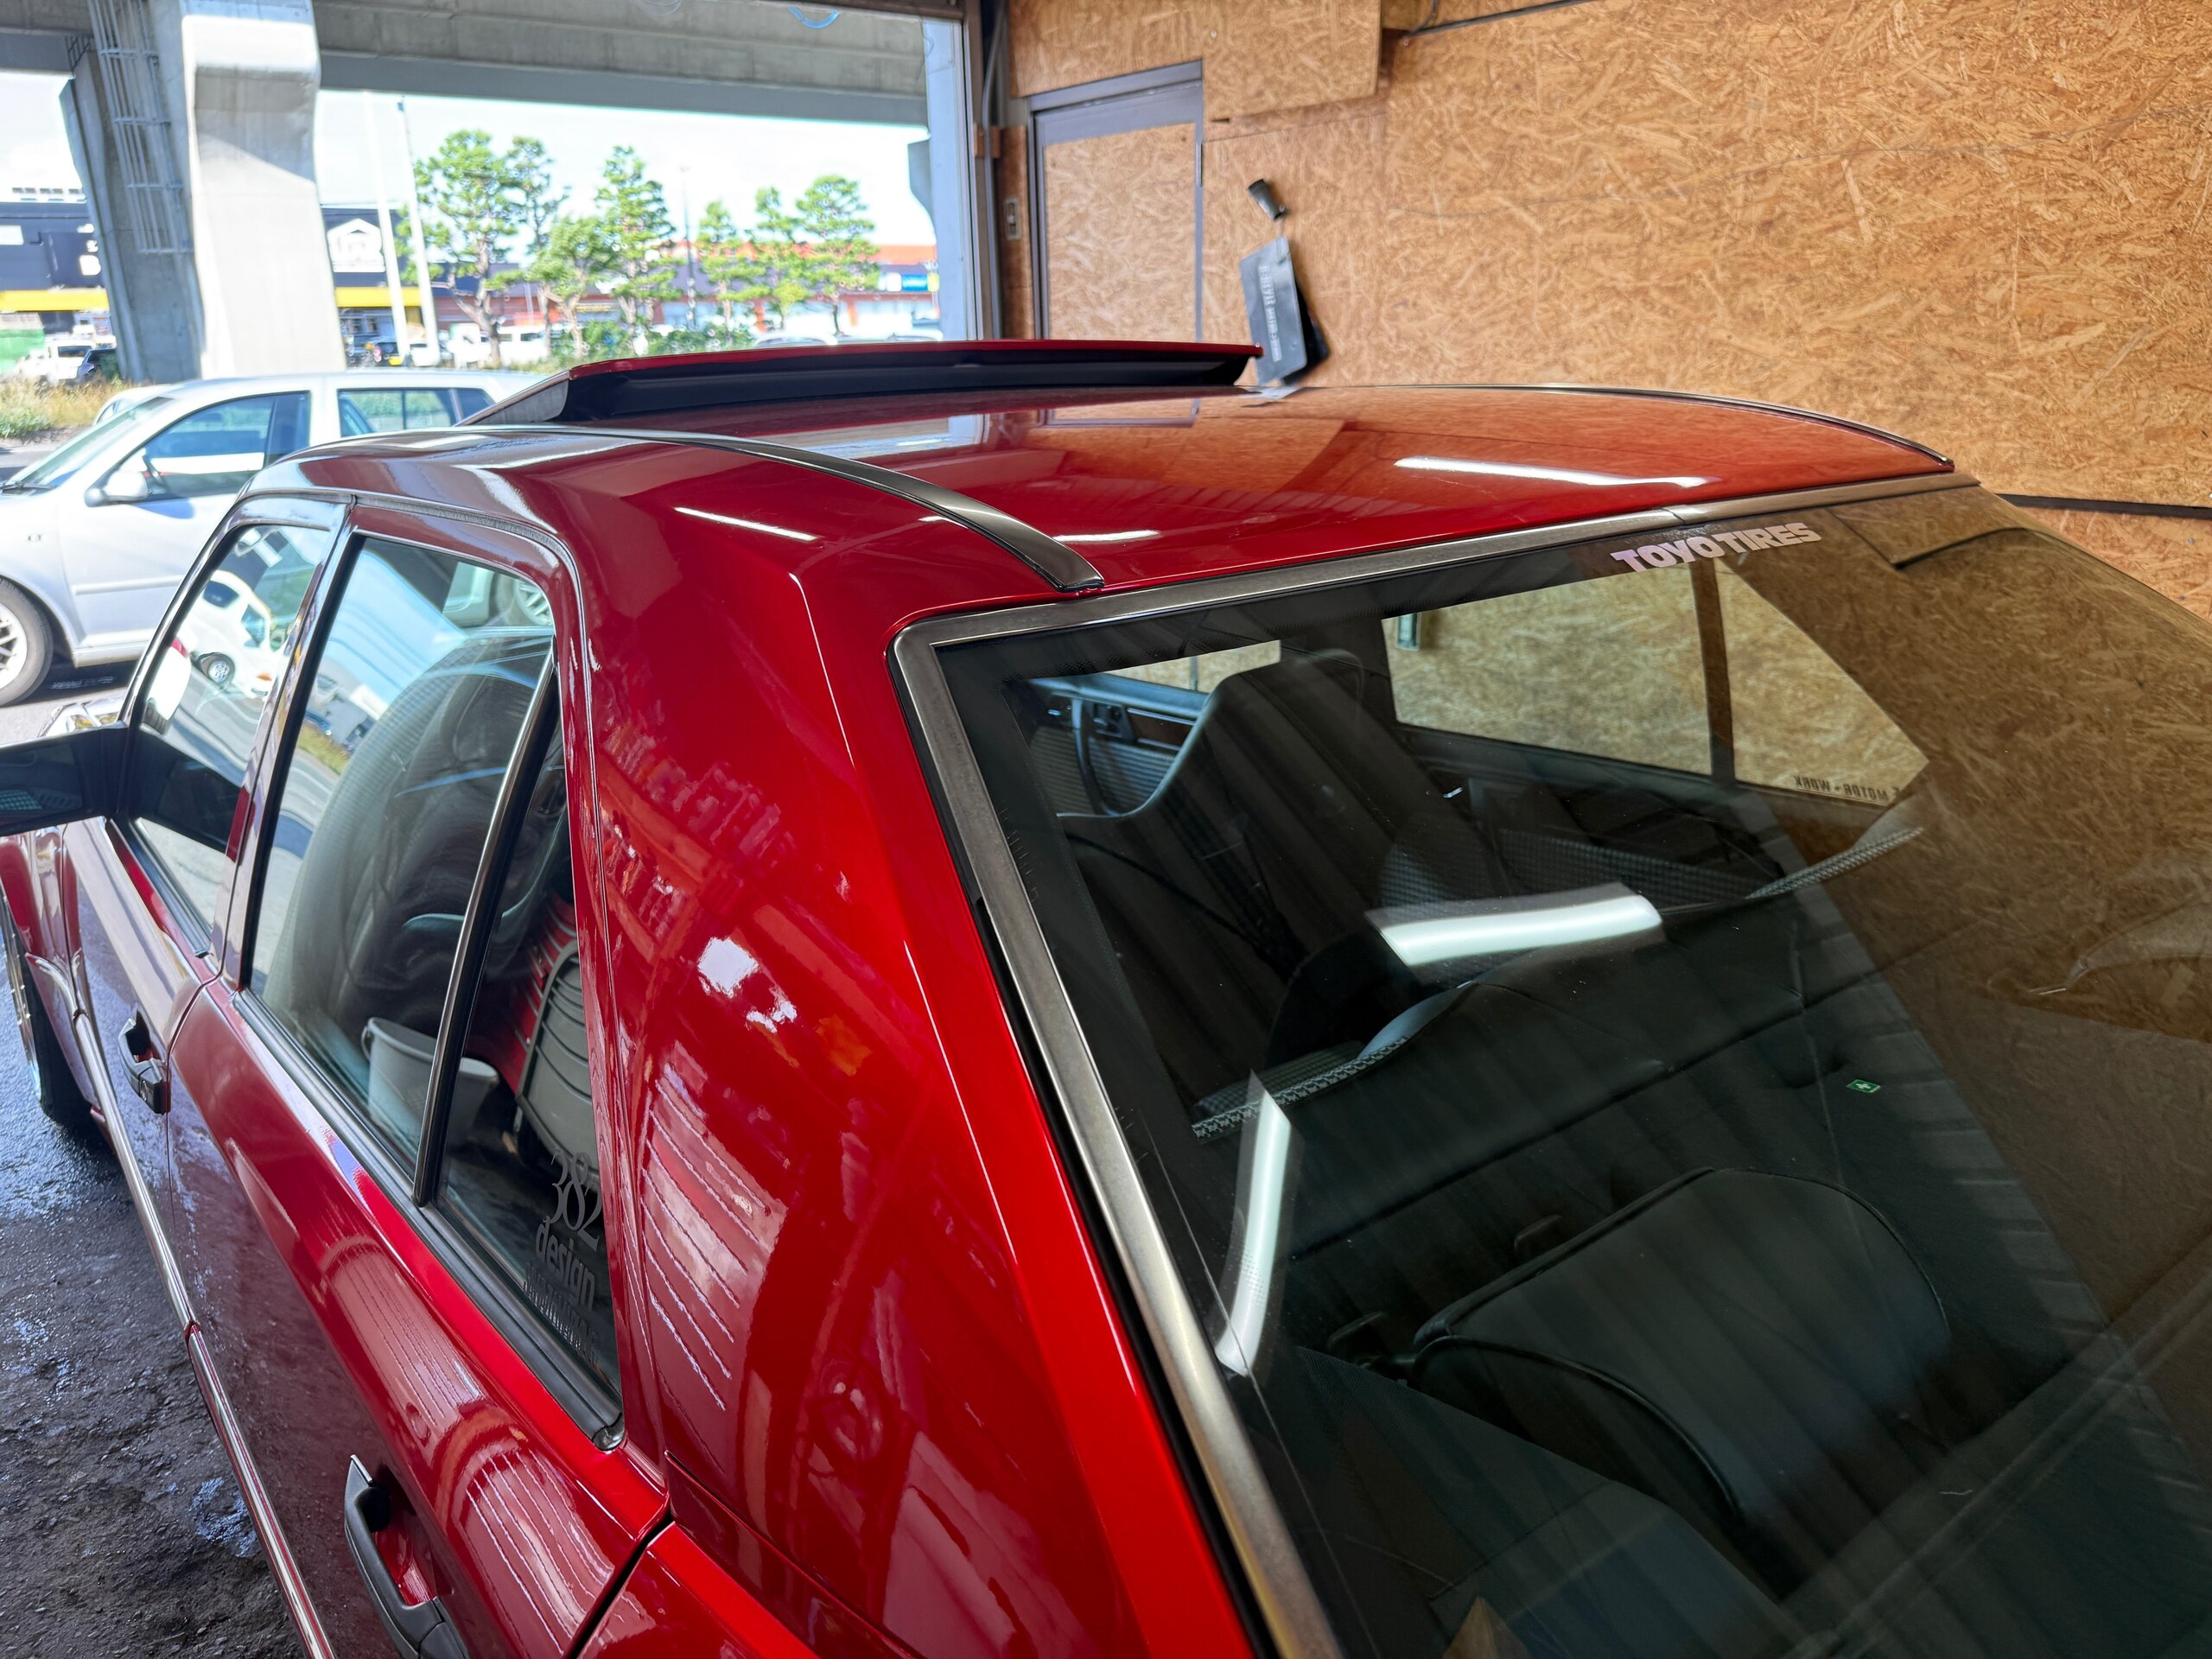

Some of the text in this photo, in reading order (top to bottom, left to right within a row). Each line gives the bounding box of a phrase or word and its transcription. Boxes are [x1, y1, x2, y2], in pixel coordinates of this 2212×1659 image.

[1611, 522, 1821, 572] TOYO TIRES
[535, 1215, 595, 1313] design
